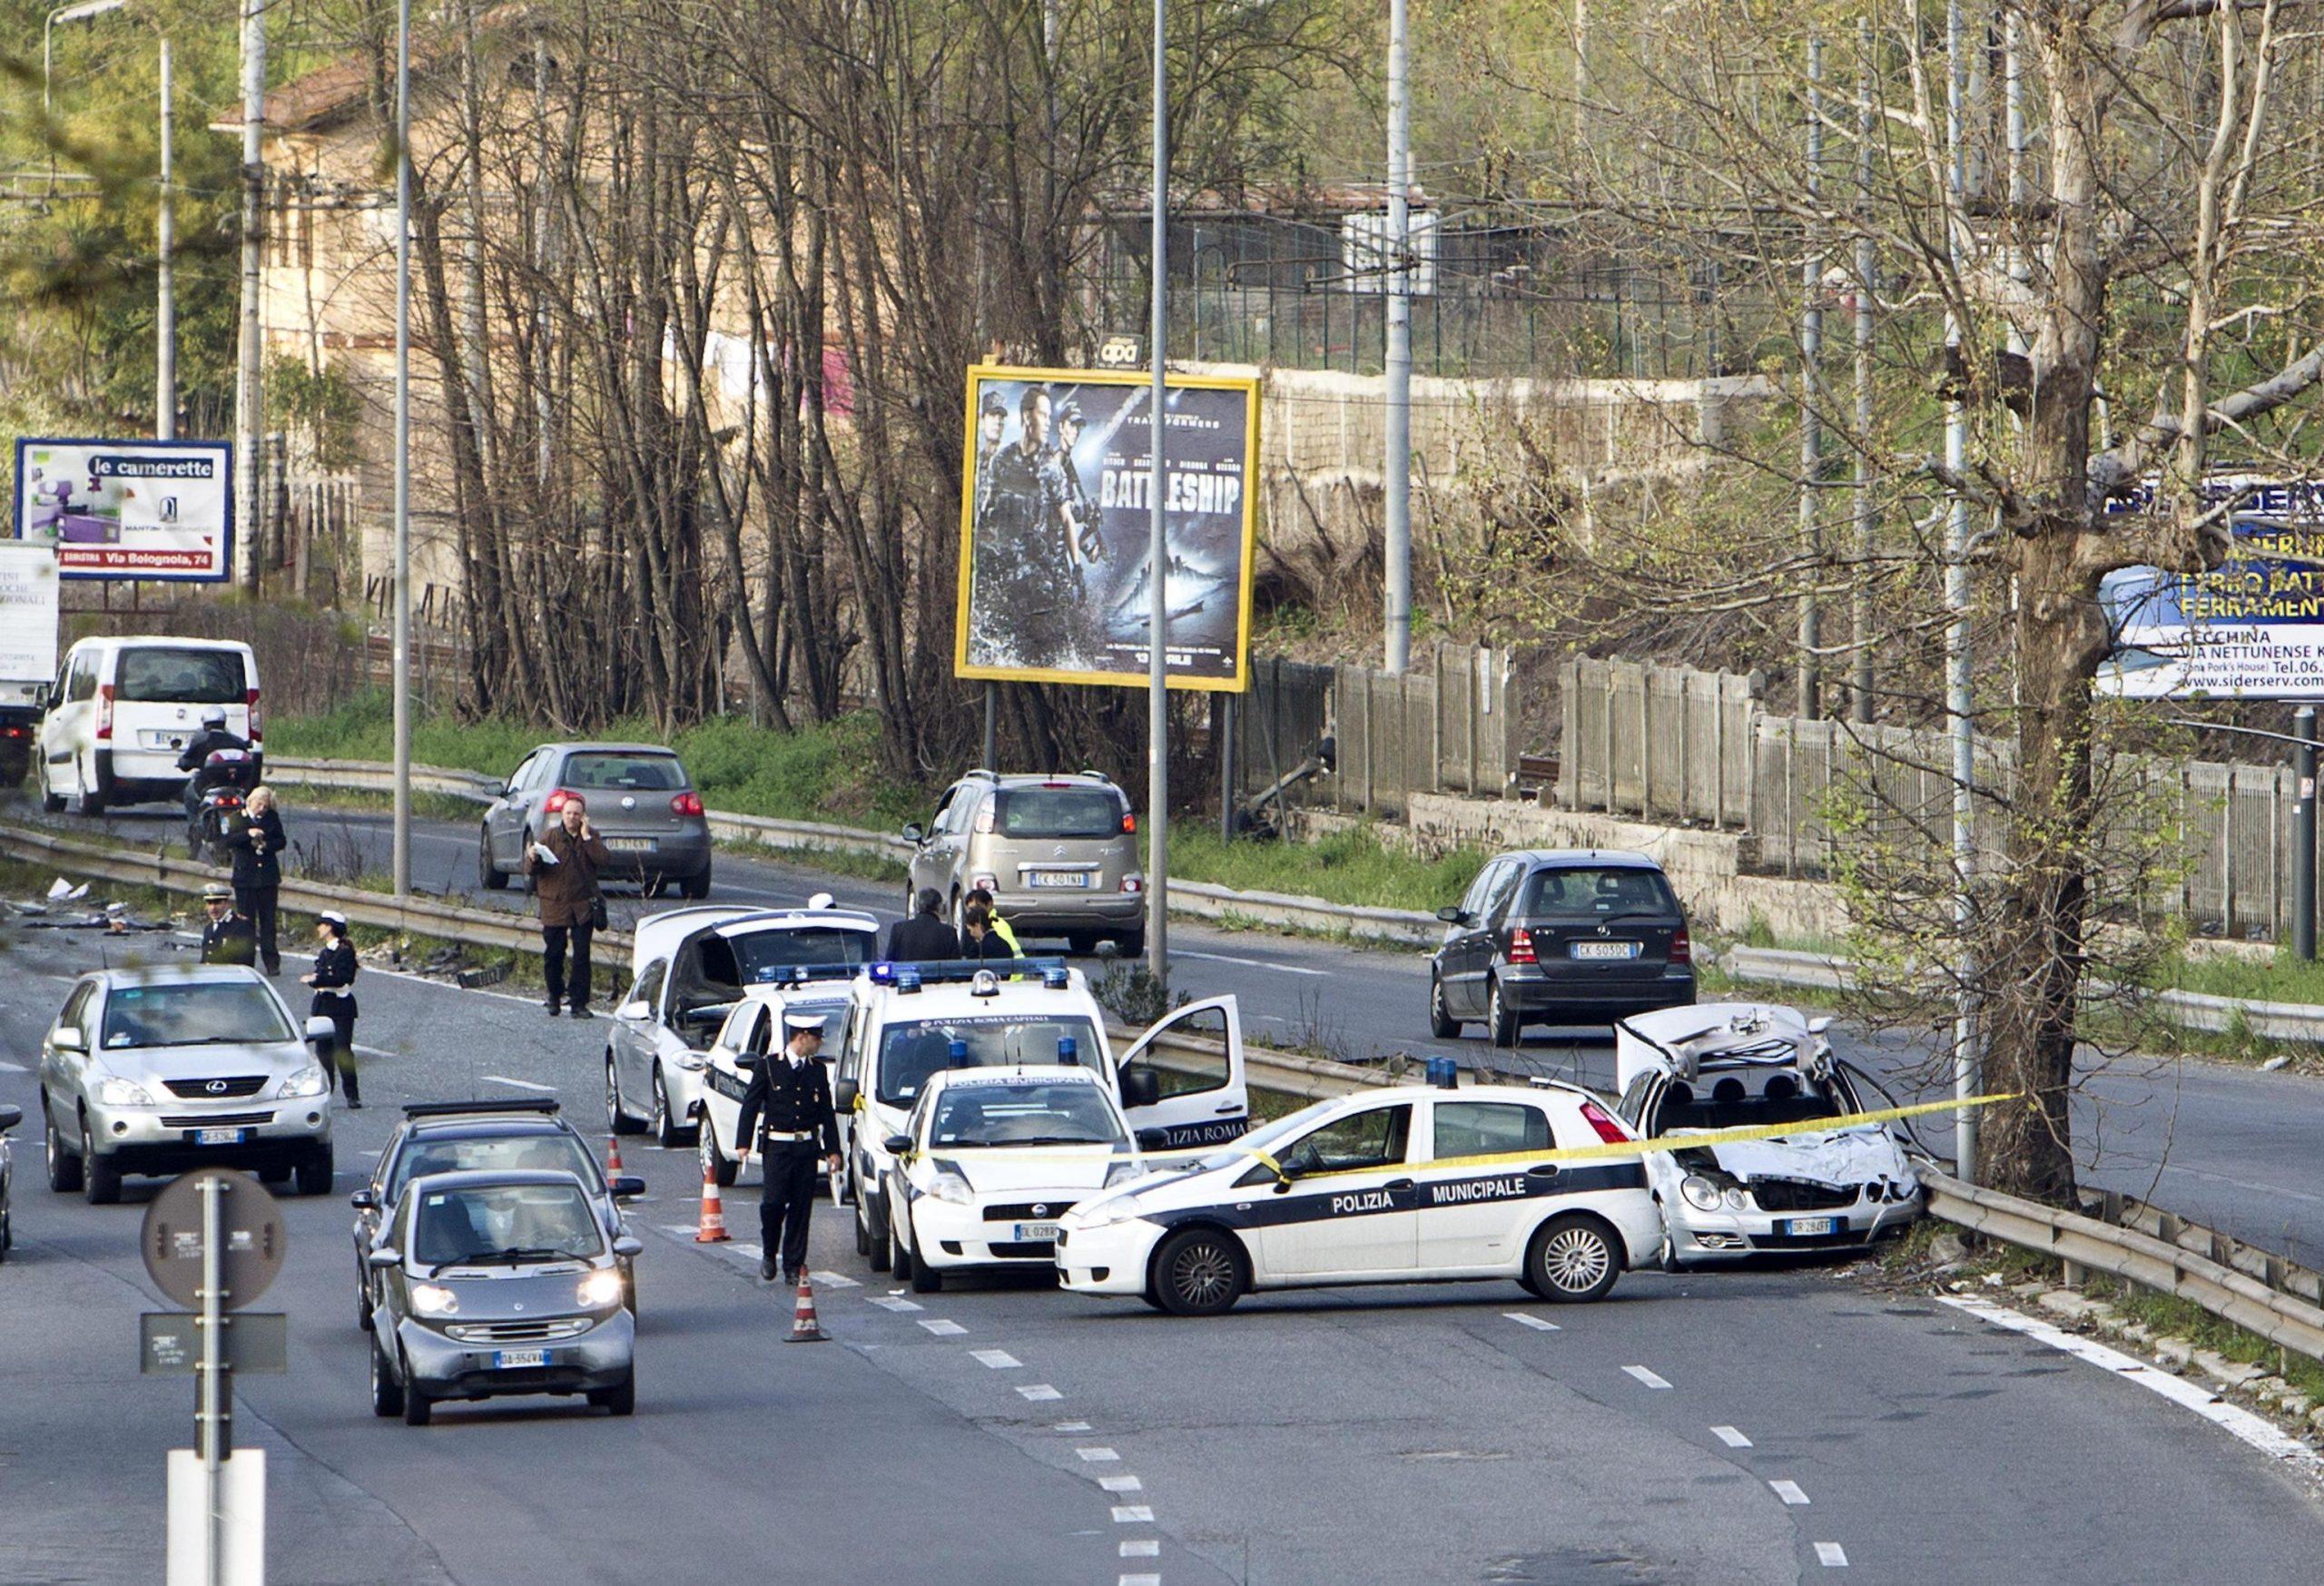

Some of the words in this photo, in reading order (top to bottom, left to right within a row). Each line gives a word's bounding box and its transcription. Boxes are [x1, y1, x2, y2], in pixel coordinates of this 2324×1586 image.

[94, 458, 112, 474] le
[117, 460, 212, 476] camerette
[106, 553, 125, 564] Via
[194, 555, 209, 565] 74
[2211, 645, 2311, 659] NETTUNENSE
[2208, 662, 2234, 673] Pork's
[2237, 662, 2270, 673] House)
[1204, 1123, 1246, 1141] ROMA
[1333, 1191, 1394, 1213] POLIZIA
[1433, 1177, 1526, 1203] MUNICIPALE
